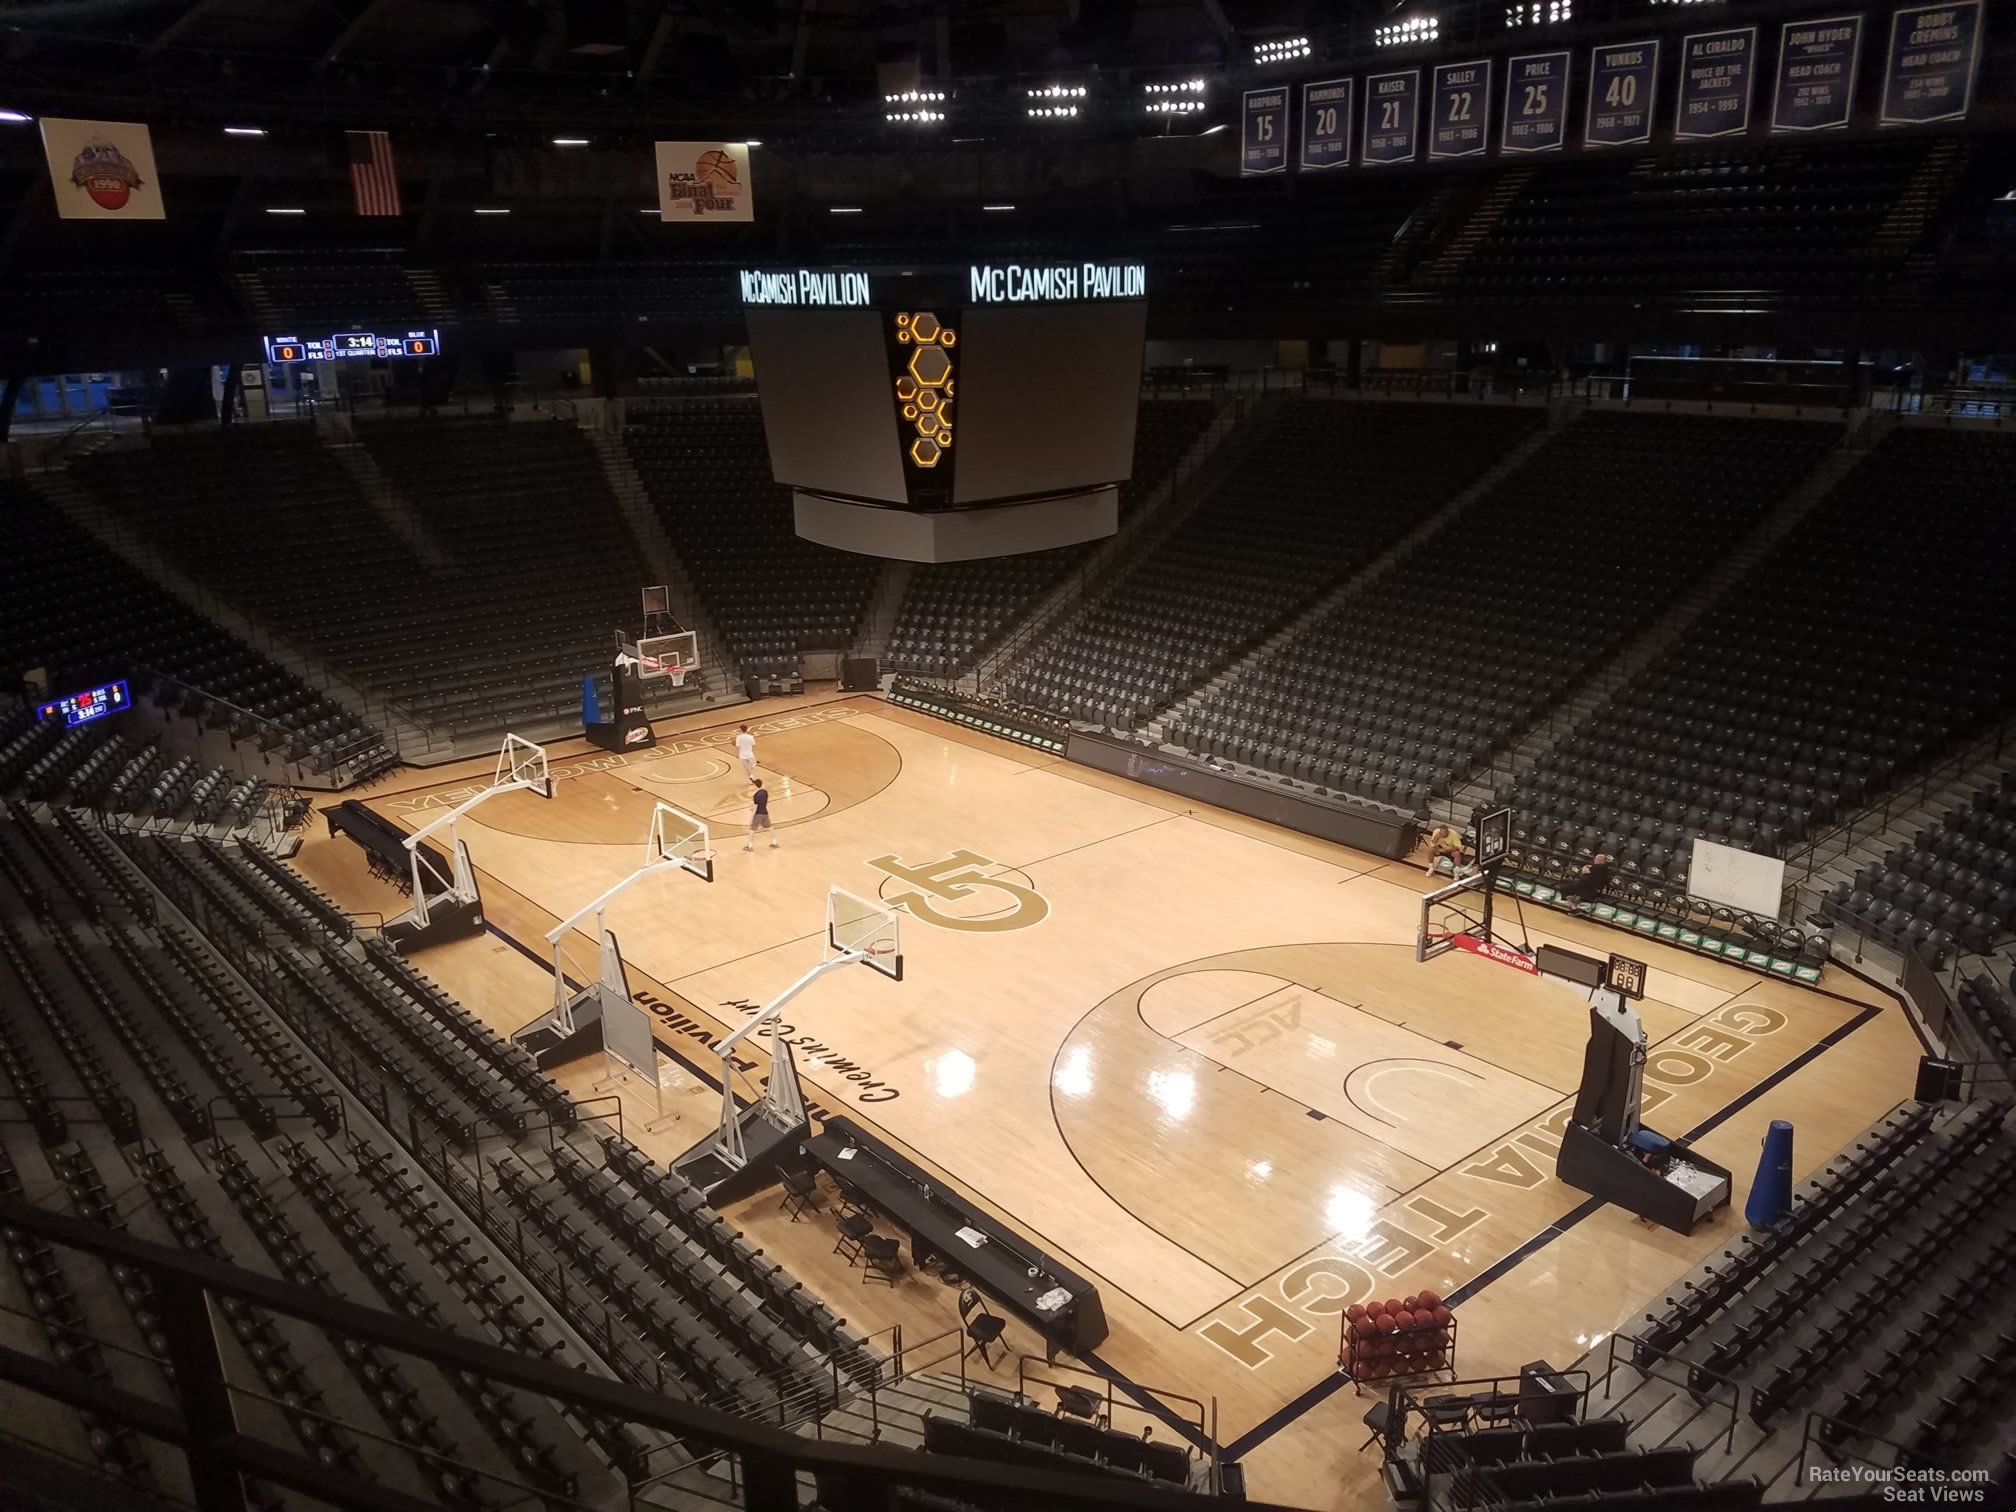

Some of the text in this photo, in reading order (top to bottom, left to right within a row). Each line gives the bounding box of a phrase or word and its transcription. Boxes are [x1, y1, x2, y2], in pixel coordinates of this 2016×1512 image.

[1693, 39, 1745, 56] AL CIRALDO
[1902, 50, 1961, 67] HEAD COACH
[1447, 70, 1476, 85] SALLEY
[1525, 62, 1550, 76] PRICE
[1715, 67, 1726, 77] OF
[1789, 63, 1841, 78] HEAD COACH
[1379, 80, 1405, 94] KAISER
[1605, 75, 1636, 107] 40
[1699, 77, 1731, 89] JACKETS
[1448, 92, 1472, 122] 22
[1523, 85, 1548, 115] 25
[1688, 102, 1708, 114] 1954
[1316, 108, 1337, 136] 20
[1381, 101, 1400, 129] 21
[1256, 115, 1273, 141] 15
[669, 173, 696, 181] NCAA
[670, 181, 714, 200] Final
[693, 197, 736, 215] Four
[799, 270, 870, 306] PAVILION
[1083, 262, 1146, 299] PAVILION
[348, 336, 374, 348] 3:14
[387, 338, 402, 346] TOL
[414, 341, 423, 352] 0
[283, 347, 293, 359] 0
[789, 1035, 899, 1104] Cremins
[1197, 1003, 1789, 1370] GEOIA TECH
